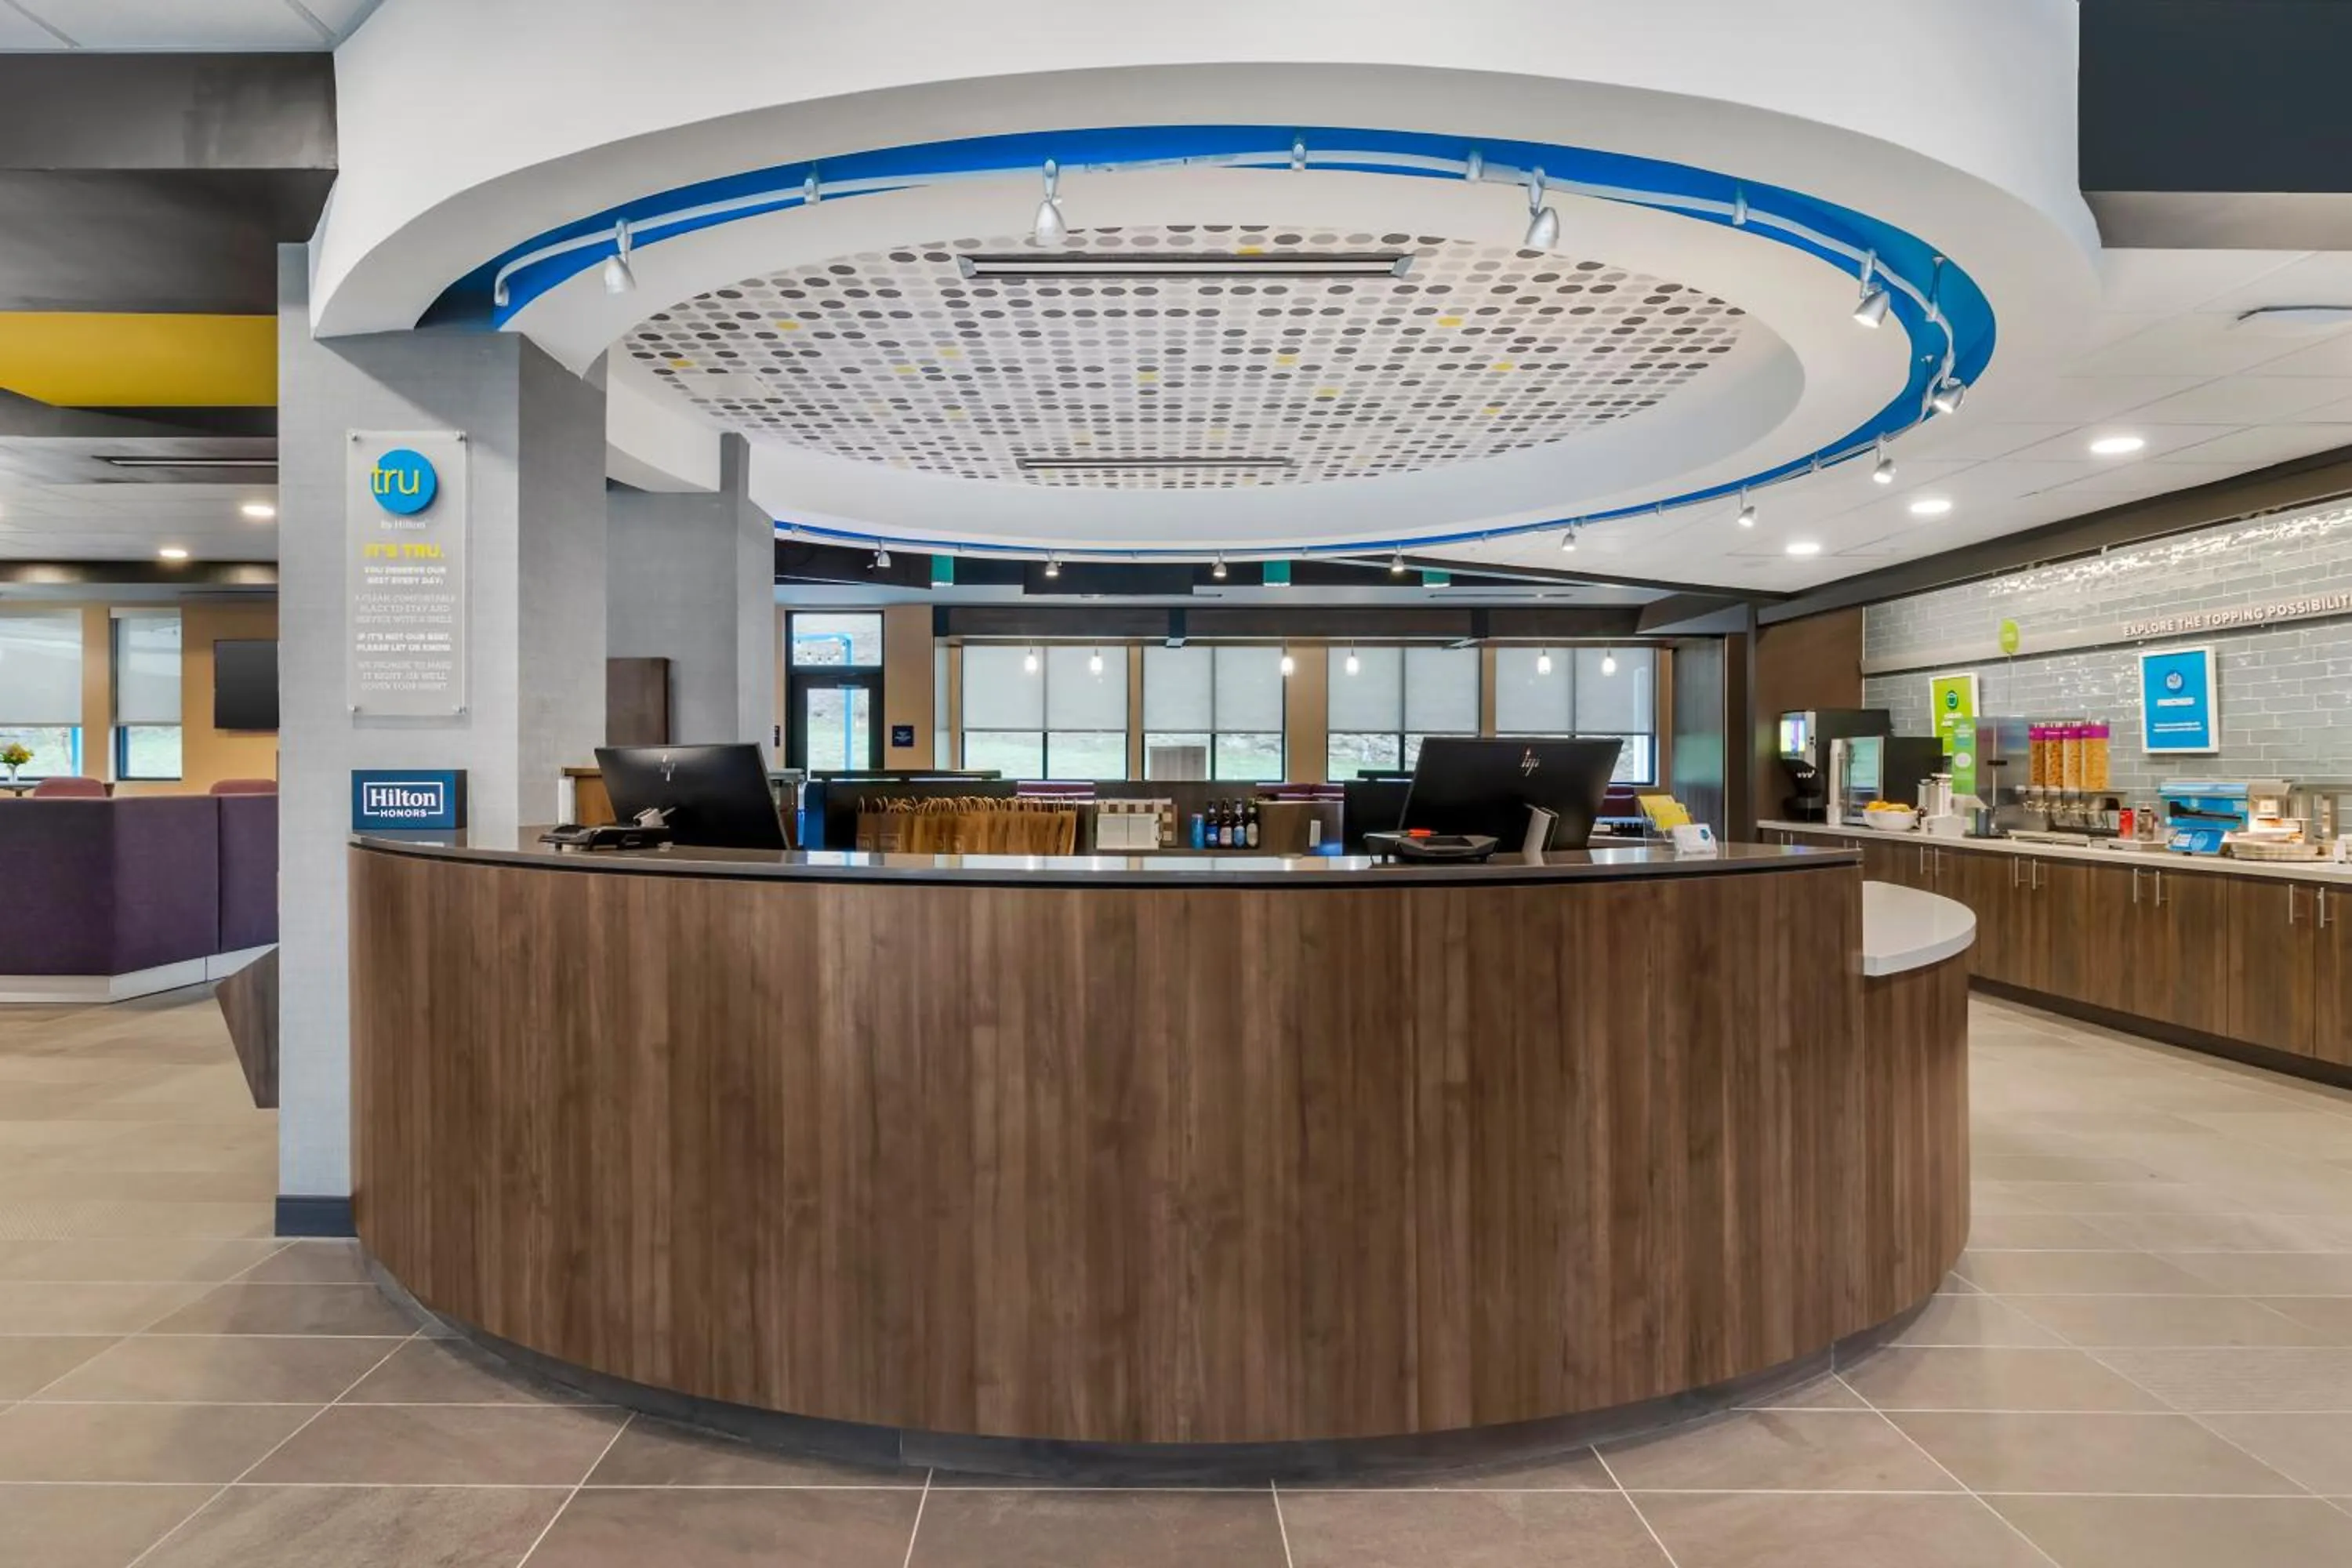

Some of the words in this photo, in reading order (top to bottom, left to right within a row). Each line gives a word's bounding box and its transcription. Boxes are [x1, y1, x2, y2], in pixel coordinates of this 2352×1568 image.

[372, 465, 419, 495] tru
[394, 520, 426, 528] Hilton
[363, 543, 398, 559] IT'S
[403, 543, 445, 559] TRU.
[2124, 619, 2176, 636] EXPLORE
[2178, 615, 2202, 630] THE
[2207, 607, 2264, 626] TOPPING
[370, 788, 437, 807] Hilton
[379, 809, 427, 818] HONORS
